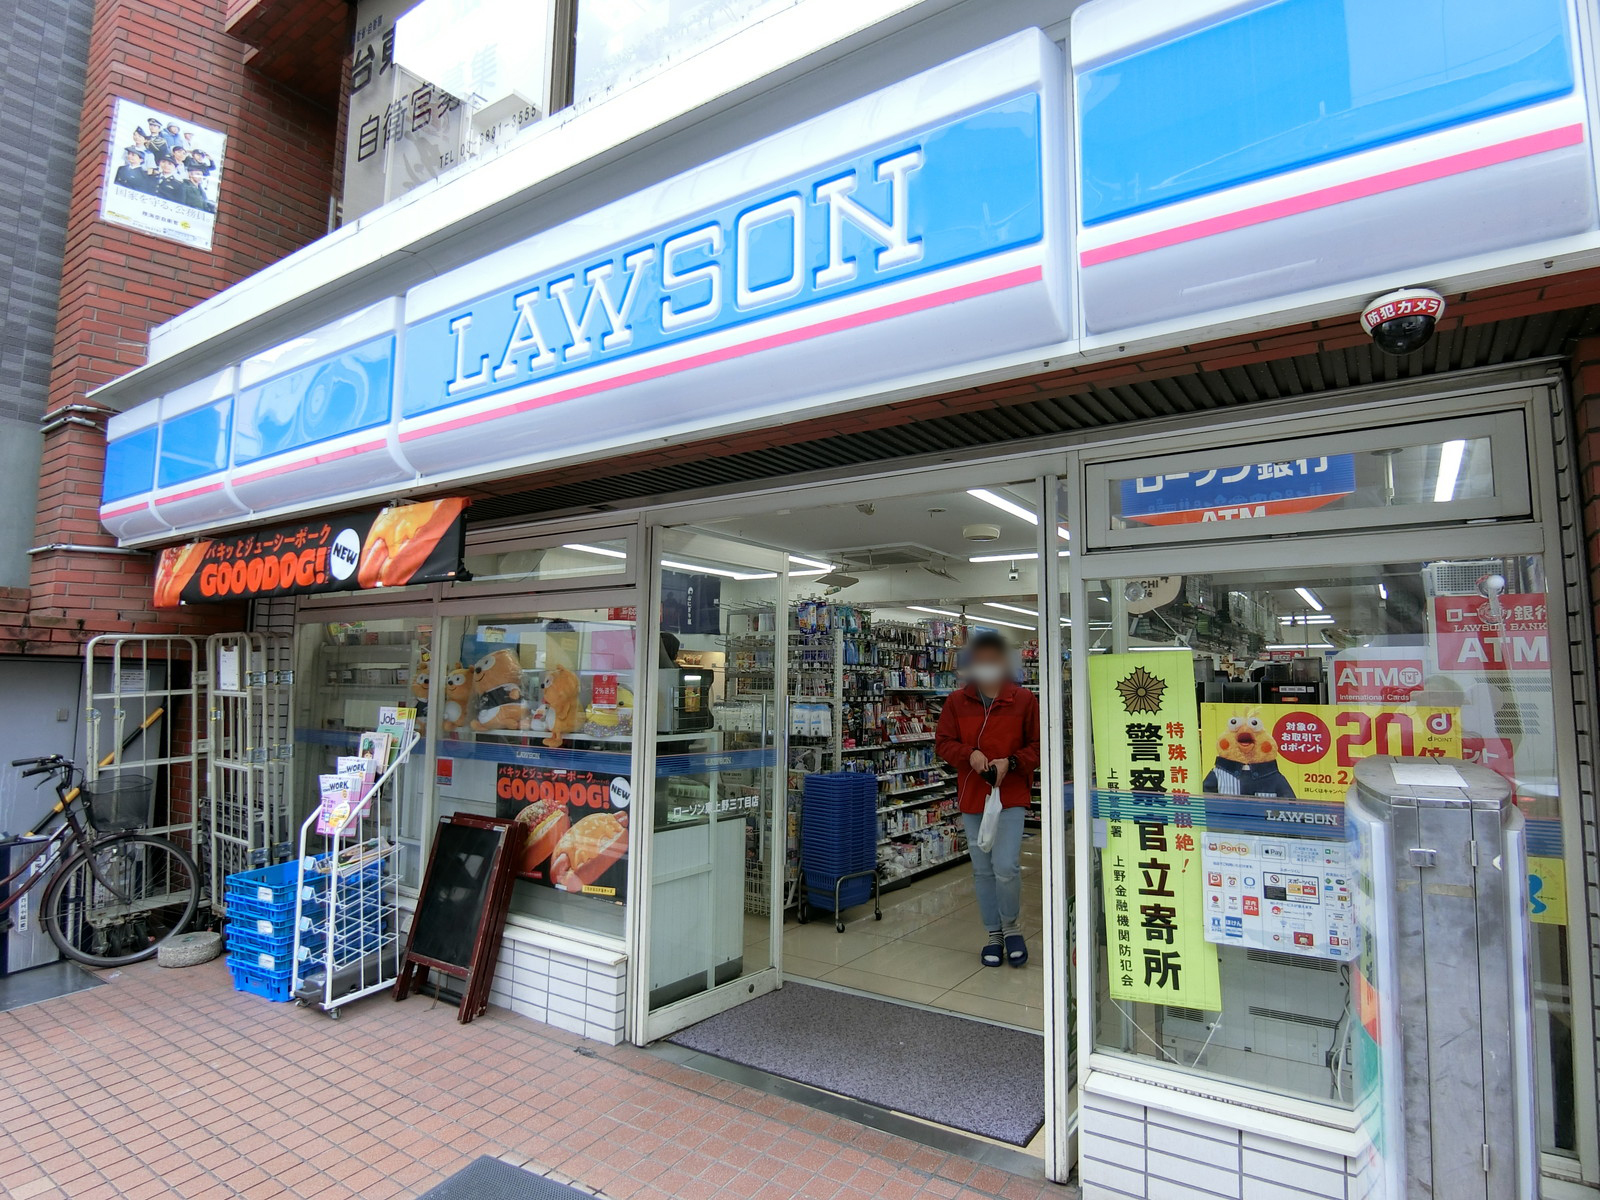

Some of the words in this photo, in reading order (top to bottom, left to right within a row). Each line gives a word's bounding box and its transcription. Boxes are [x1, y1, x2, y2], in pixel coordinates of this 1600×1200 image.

[447, 147, 923, 396] LAWSON
[1367, 300, 1439, 326] 防犯カメラ
[205, 524, 332, 561] パキッとジューシーポーク
[332, 542, 358, 565] NEW
[200, 546, 328, 597] GOOODOG!
[1457, 635, 1549, 663] ATM
[1338, 667, 1399, 687] ATM
[1339, 693, 1385, 701] International
[1285, 722, 1317, 732] 対象の
[1281, 732, 1322, 743] お取引で
[516, 751, 540, 760] LAWSON
[1280, 742, 1323, 753] dポイント
[346, 763, 366, 772] WORK
[705, 757, 732, 766] LAWSON
[498, 766, 594, 783] パキッとジューシーポーク
[329, 780, 349, 791] WORK
[497, 776, 610, 809] GOOODOG!
[610, 784, 630, 800] NEW
[673, 795, 759, 817] ローソン東上野三丁目店
[1265, 809, 1337, 826] LAWSON
[1125, 722, 1181, 991] 警察官立寄所
[1220, 844, 1247, 853] Ponta
[1270, 849, 1283, 858] Pay
[1113, 855, 1133, 987] 上野金融機関防犯会
